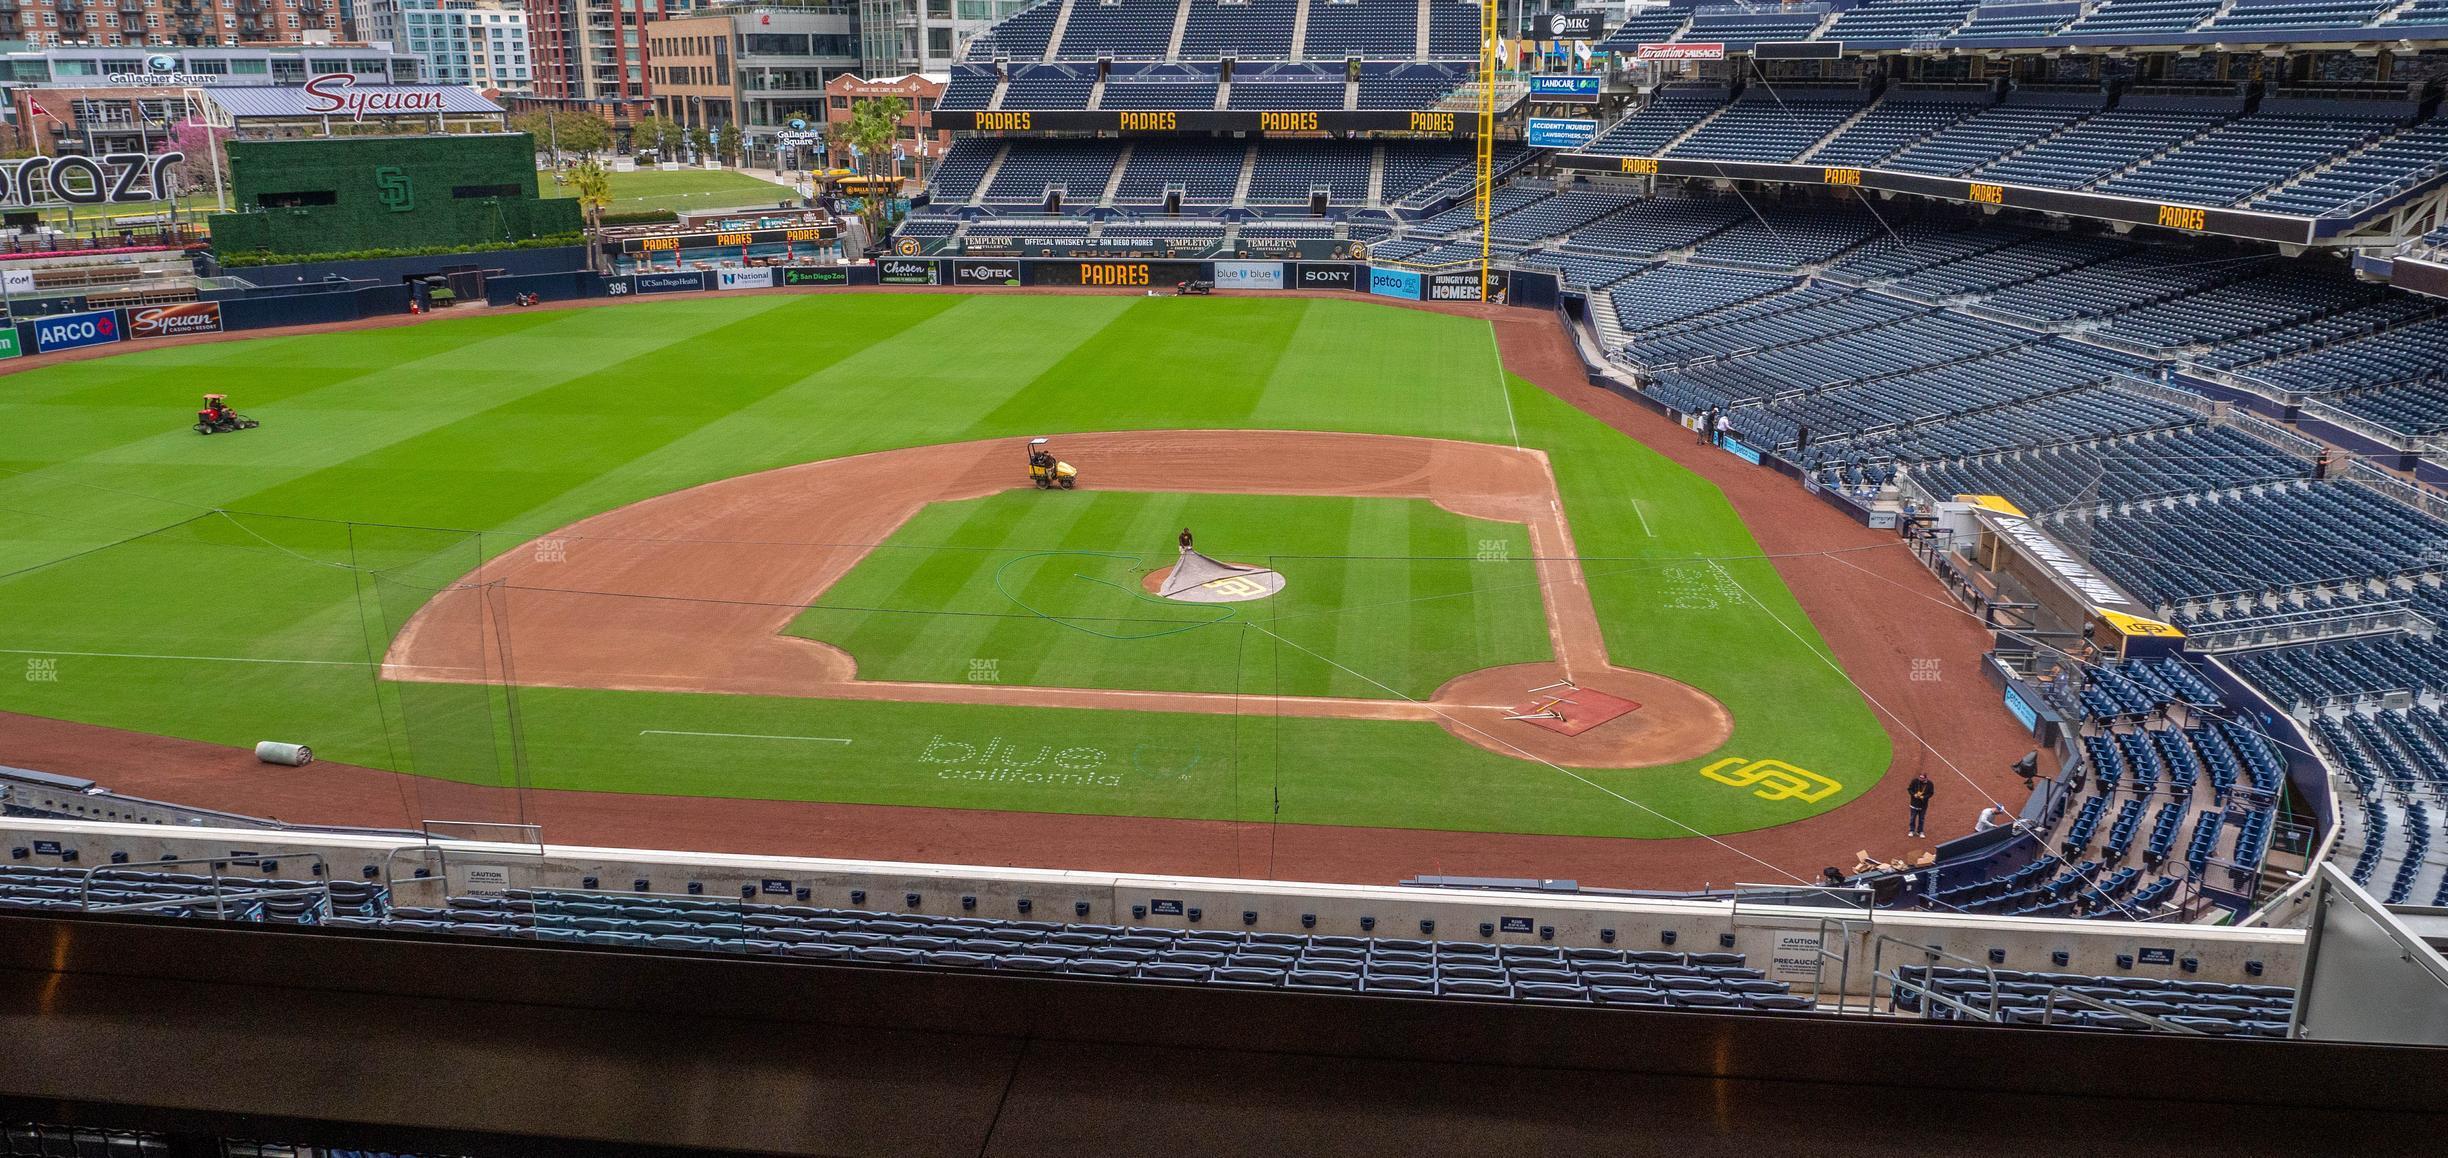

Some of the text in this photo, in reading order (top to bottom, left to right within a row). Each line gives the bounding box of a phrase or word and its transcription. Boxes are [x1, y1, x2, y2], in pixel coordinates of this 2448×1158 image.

[1566, 18, 1590, 29] MRC
[1639, 46, 1722, 58] Tarantino SAUSAGES
[109, 73, 217, 85] Gallagher Square
[1541, 80, 1575, 90] LANDCARE
[304, 73, 447, 123] Sycuan
[976, 112, 1031, 130] PADRES
[1121, 112, 1176, 130] PADRES
[1261, 112, 1318, 130] PADRES
[1411, 112, 1454, 132] PADRES
[777, 131, 818, 140] Gallagher
[784, 138, 813, 147] Square
[1622, 159, 1658, 174] PADRES
[1825, 168, 1861, 186] PADRES
[1970, 183, 2004, 204] PADRES
[2159, 205, 2205, 231] PADRES
[718, 233, 752, 246] PADRES
[787, 229, 820, 241] PADRES
[964, 237, 1012, 246] TEMPLETON
[643, 238, 679, 251] PADRES
[1025, 238, 1053, 246] OFFICIAL
[1054, 238, 1084, 246] WHISKEY
[1100, 238, 1112, 246] SAN
[1113, 238, 1129, 247] DIEGO
[1131, 239, 1153, 247] PADRES
[1164, 239, 1215, 247] TEMPLETON
[1246, 240, 1297, 248] TEMPLETON
[884, 261, 924, 273] Chosen
[960, 266, 1012, 280] EVOTEK
[737, 272, 769, 280] National
[1080, 264, 1149, 286] PADRES
[1217, 269, 1238, 279] blue
[1250, 269, 1271, 279] blue
[1306, 271, 1350, 281] SONY
[1373, 273, 1402, 288] petco
[1435, 276, 1479, 285] HUNGRY FOR
[609, 282, 628, 295] 396
[663, 279, 679, 287] Diego
[1432, 285, 1481, 299] HOMERS
[135, 308, 214, 334] Sycuan
[40, 321, 95, 345] ARCO
[918, 734, 1107, 769] blue
[938, 768, 1123, 786] california
